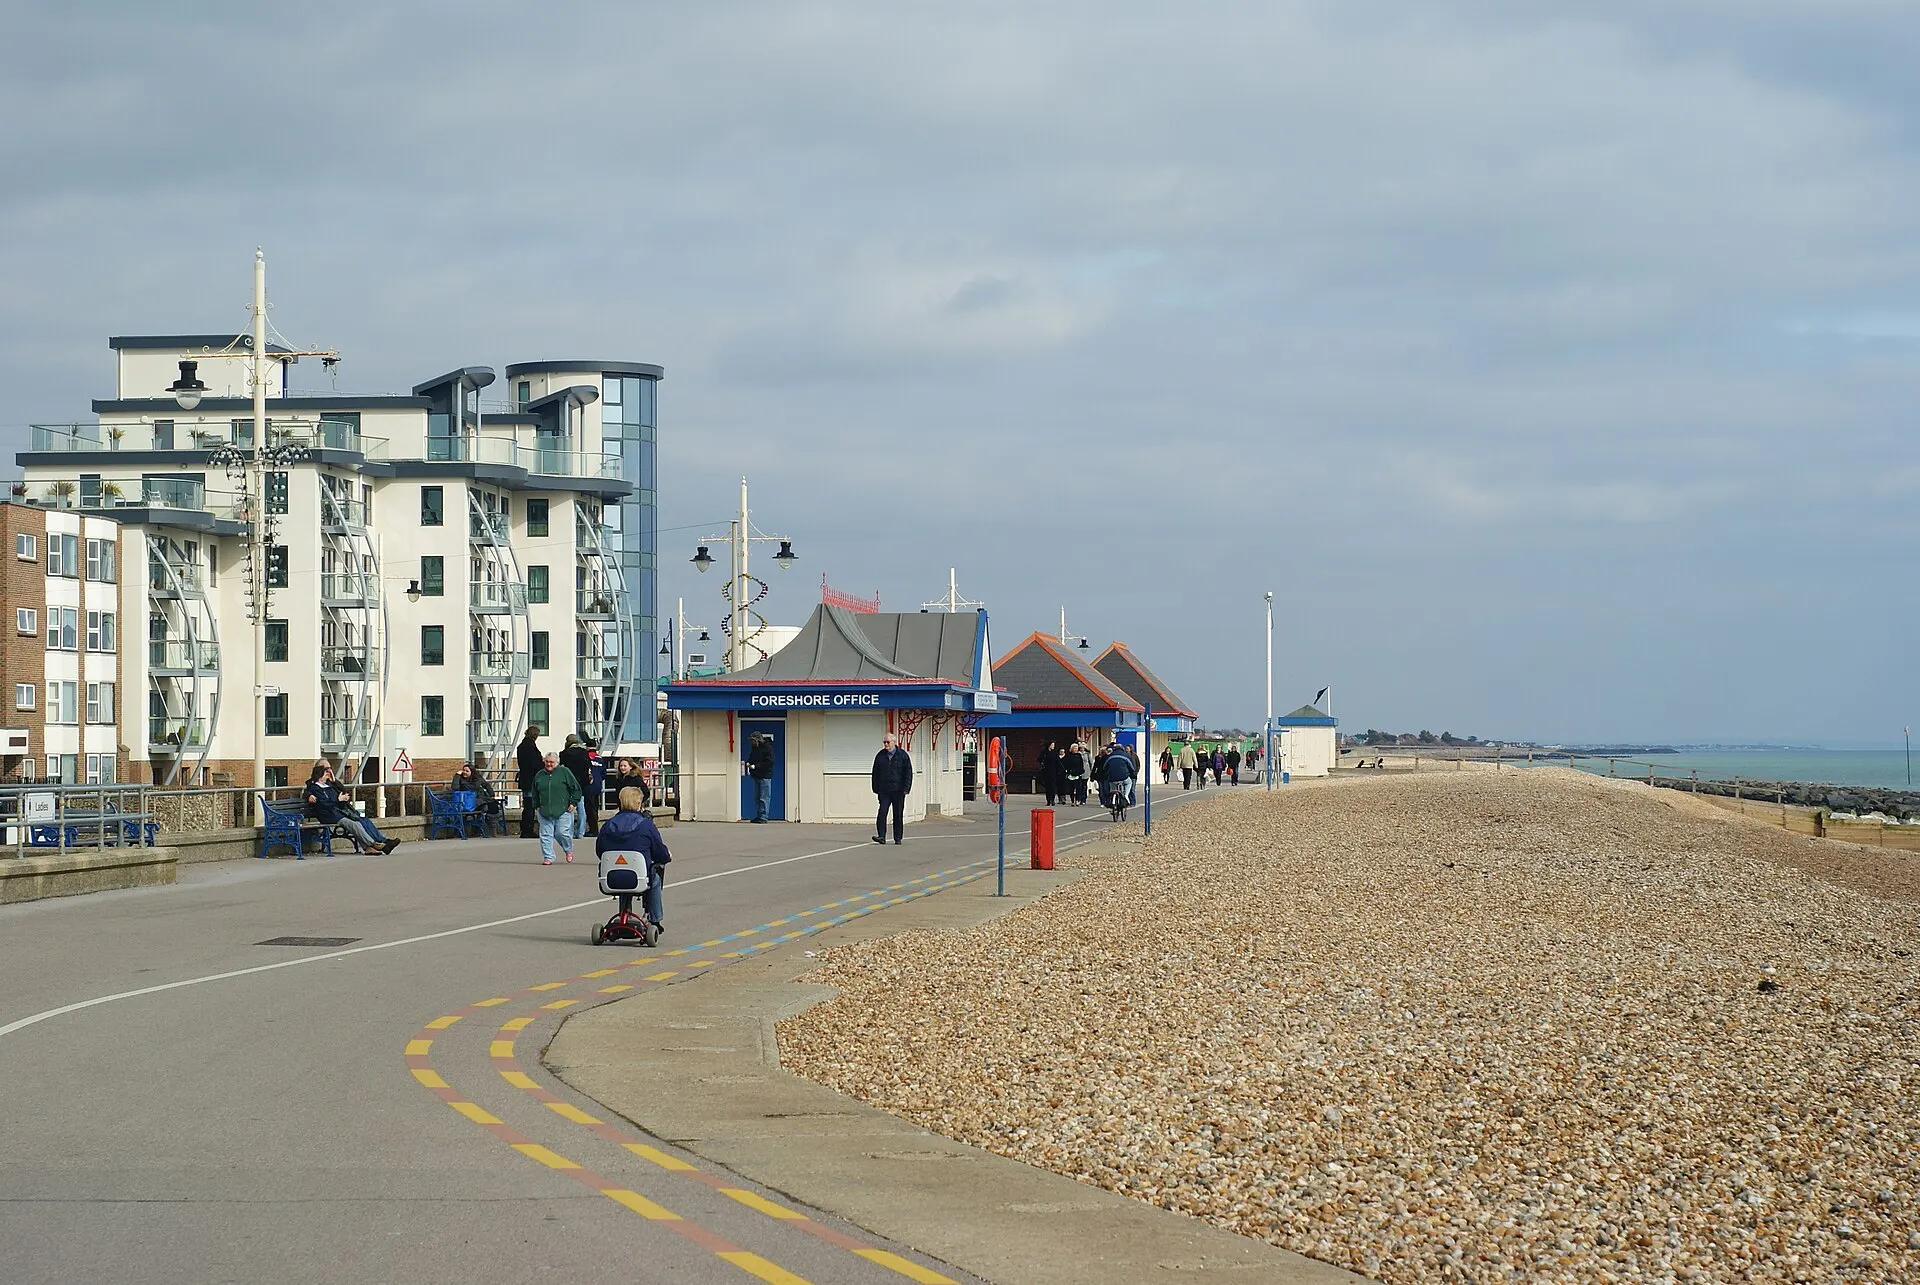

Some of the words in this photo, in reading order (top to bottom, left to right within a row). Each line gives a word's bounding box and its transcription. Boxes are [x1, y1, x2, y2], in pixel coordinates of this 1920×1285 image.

[751, 695, 831, 706] FORESHORE
[833, 694, 880, 705] OFFICE
[35, 802, 49, 812] Ladies
